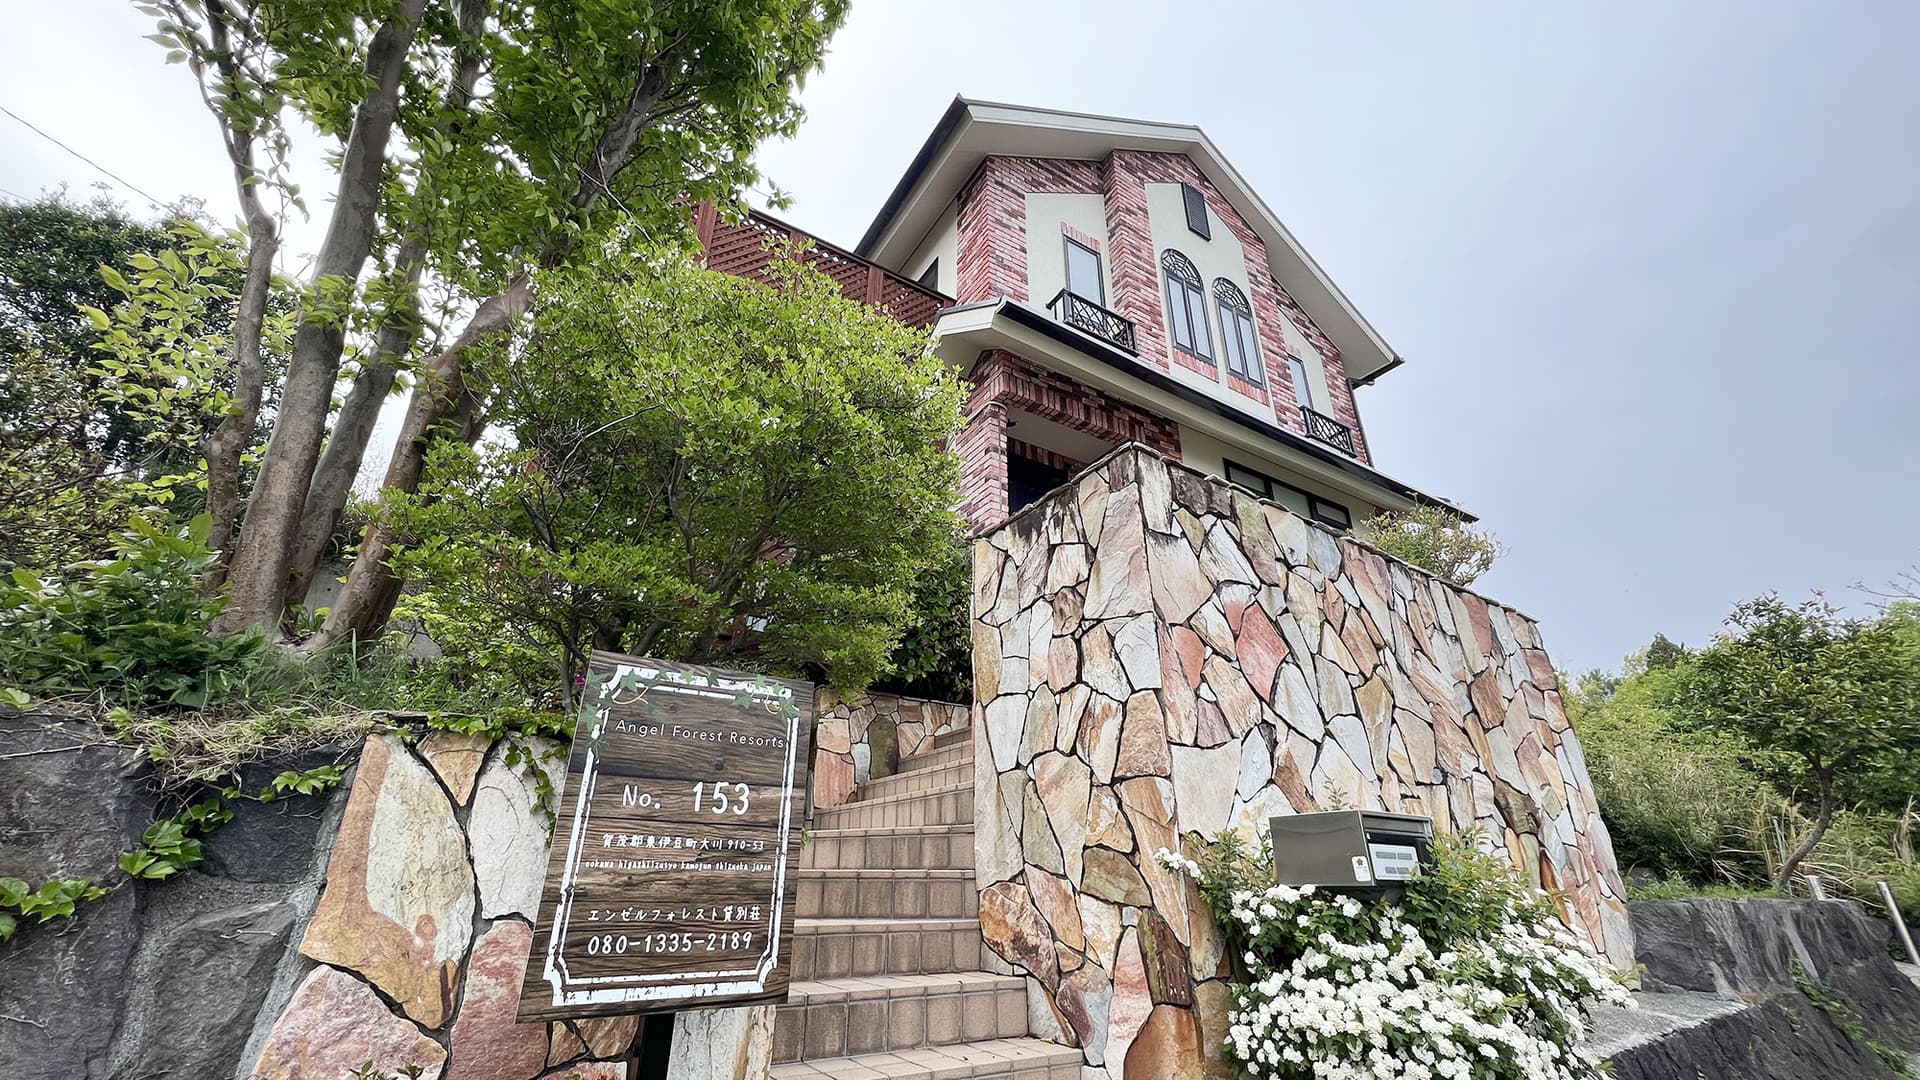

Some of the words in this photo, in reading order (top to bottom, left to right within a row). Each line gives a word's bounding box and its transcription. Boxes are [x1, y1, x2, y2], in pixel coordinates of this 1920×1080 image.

[615, 719, 665, 737] Angel
[673, 726, 723, 742] Forest
[730, 731, 784, 748] Resorts
[623, 784, 661, 809] No.
[692, 781, 750, 815] 153
[587, 905, 761, 922] エンゼルフォレスト貸別荘
[587, 931, 752, 955] 080-1335-2189
